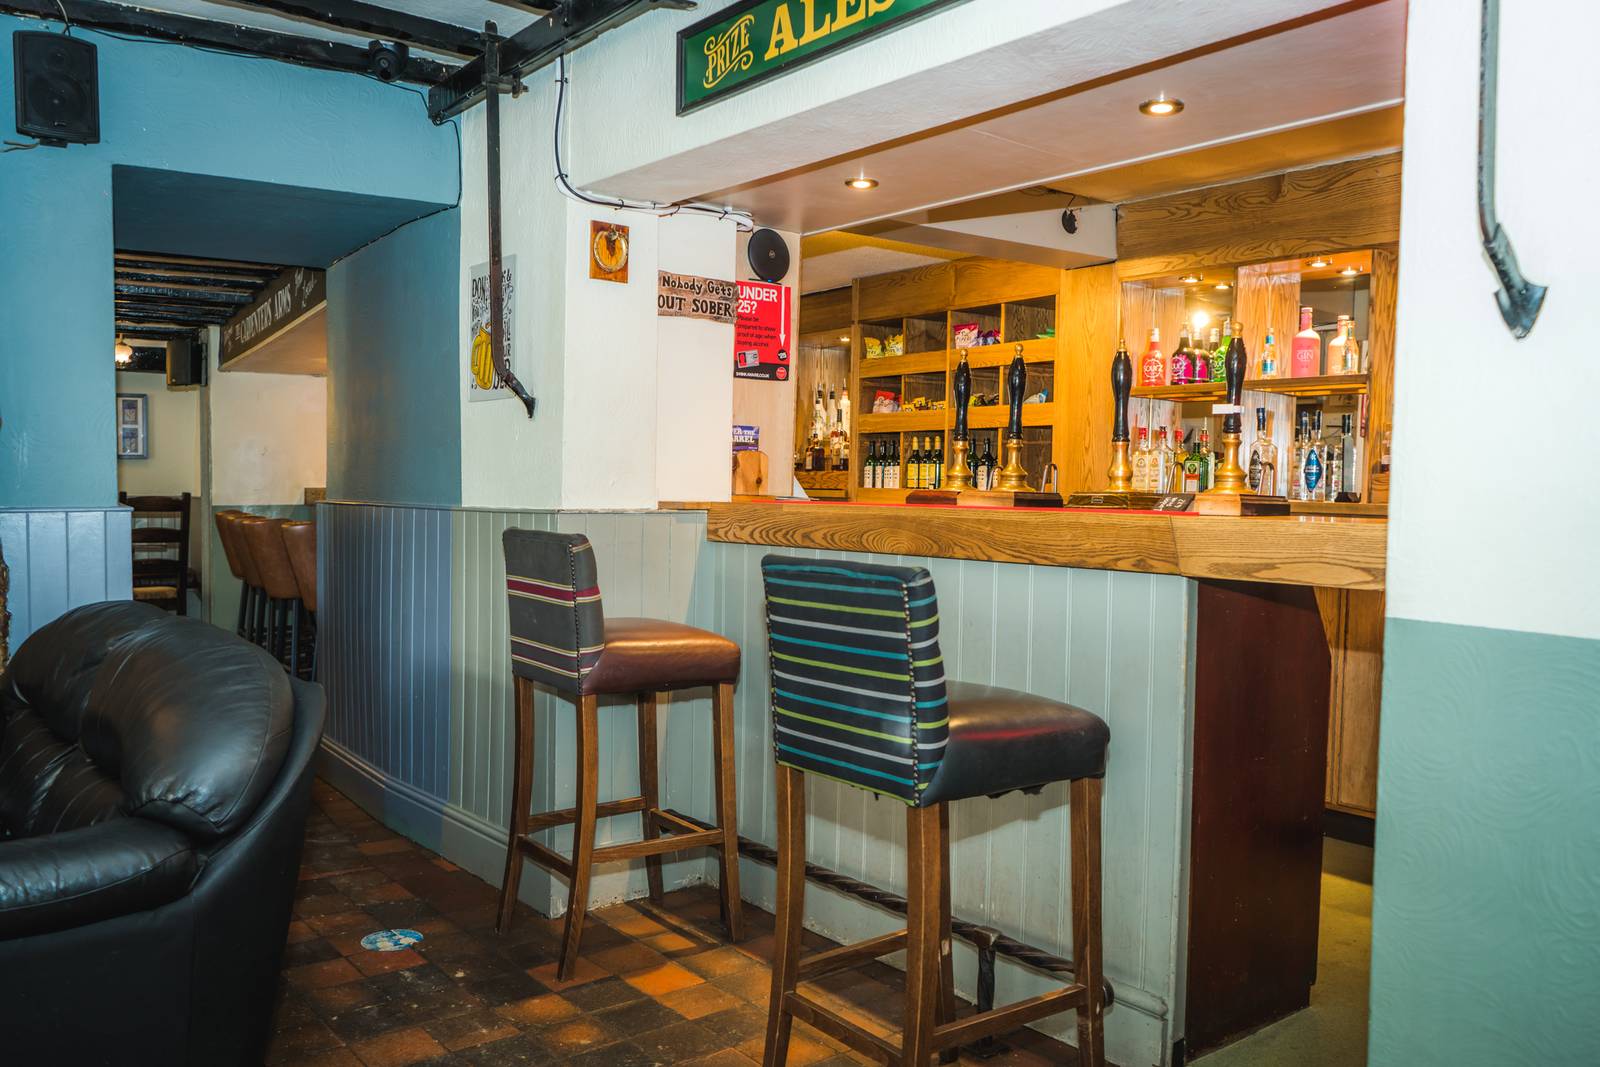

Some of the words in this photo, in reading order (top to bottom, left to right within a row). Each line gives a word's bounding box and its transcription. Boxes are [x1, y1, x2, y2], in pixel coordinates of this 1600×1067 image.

[704, 15, 754, 88] PRIZE
[662, 275, 703, 295] Nobody
[707, 281, 733, 297] Gets
[738, 285, 778, 303] UNDER
[274, 283, 292, 321] ARMS
[658, 294, 686, 311] OUT
[691, 298, 733, 318] SOBER
[737, 300, 758, 314] 25?
[1296, 351, 1314, 360] GIN
[733, 435, 755, 443] ARREL
